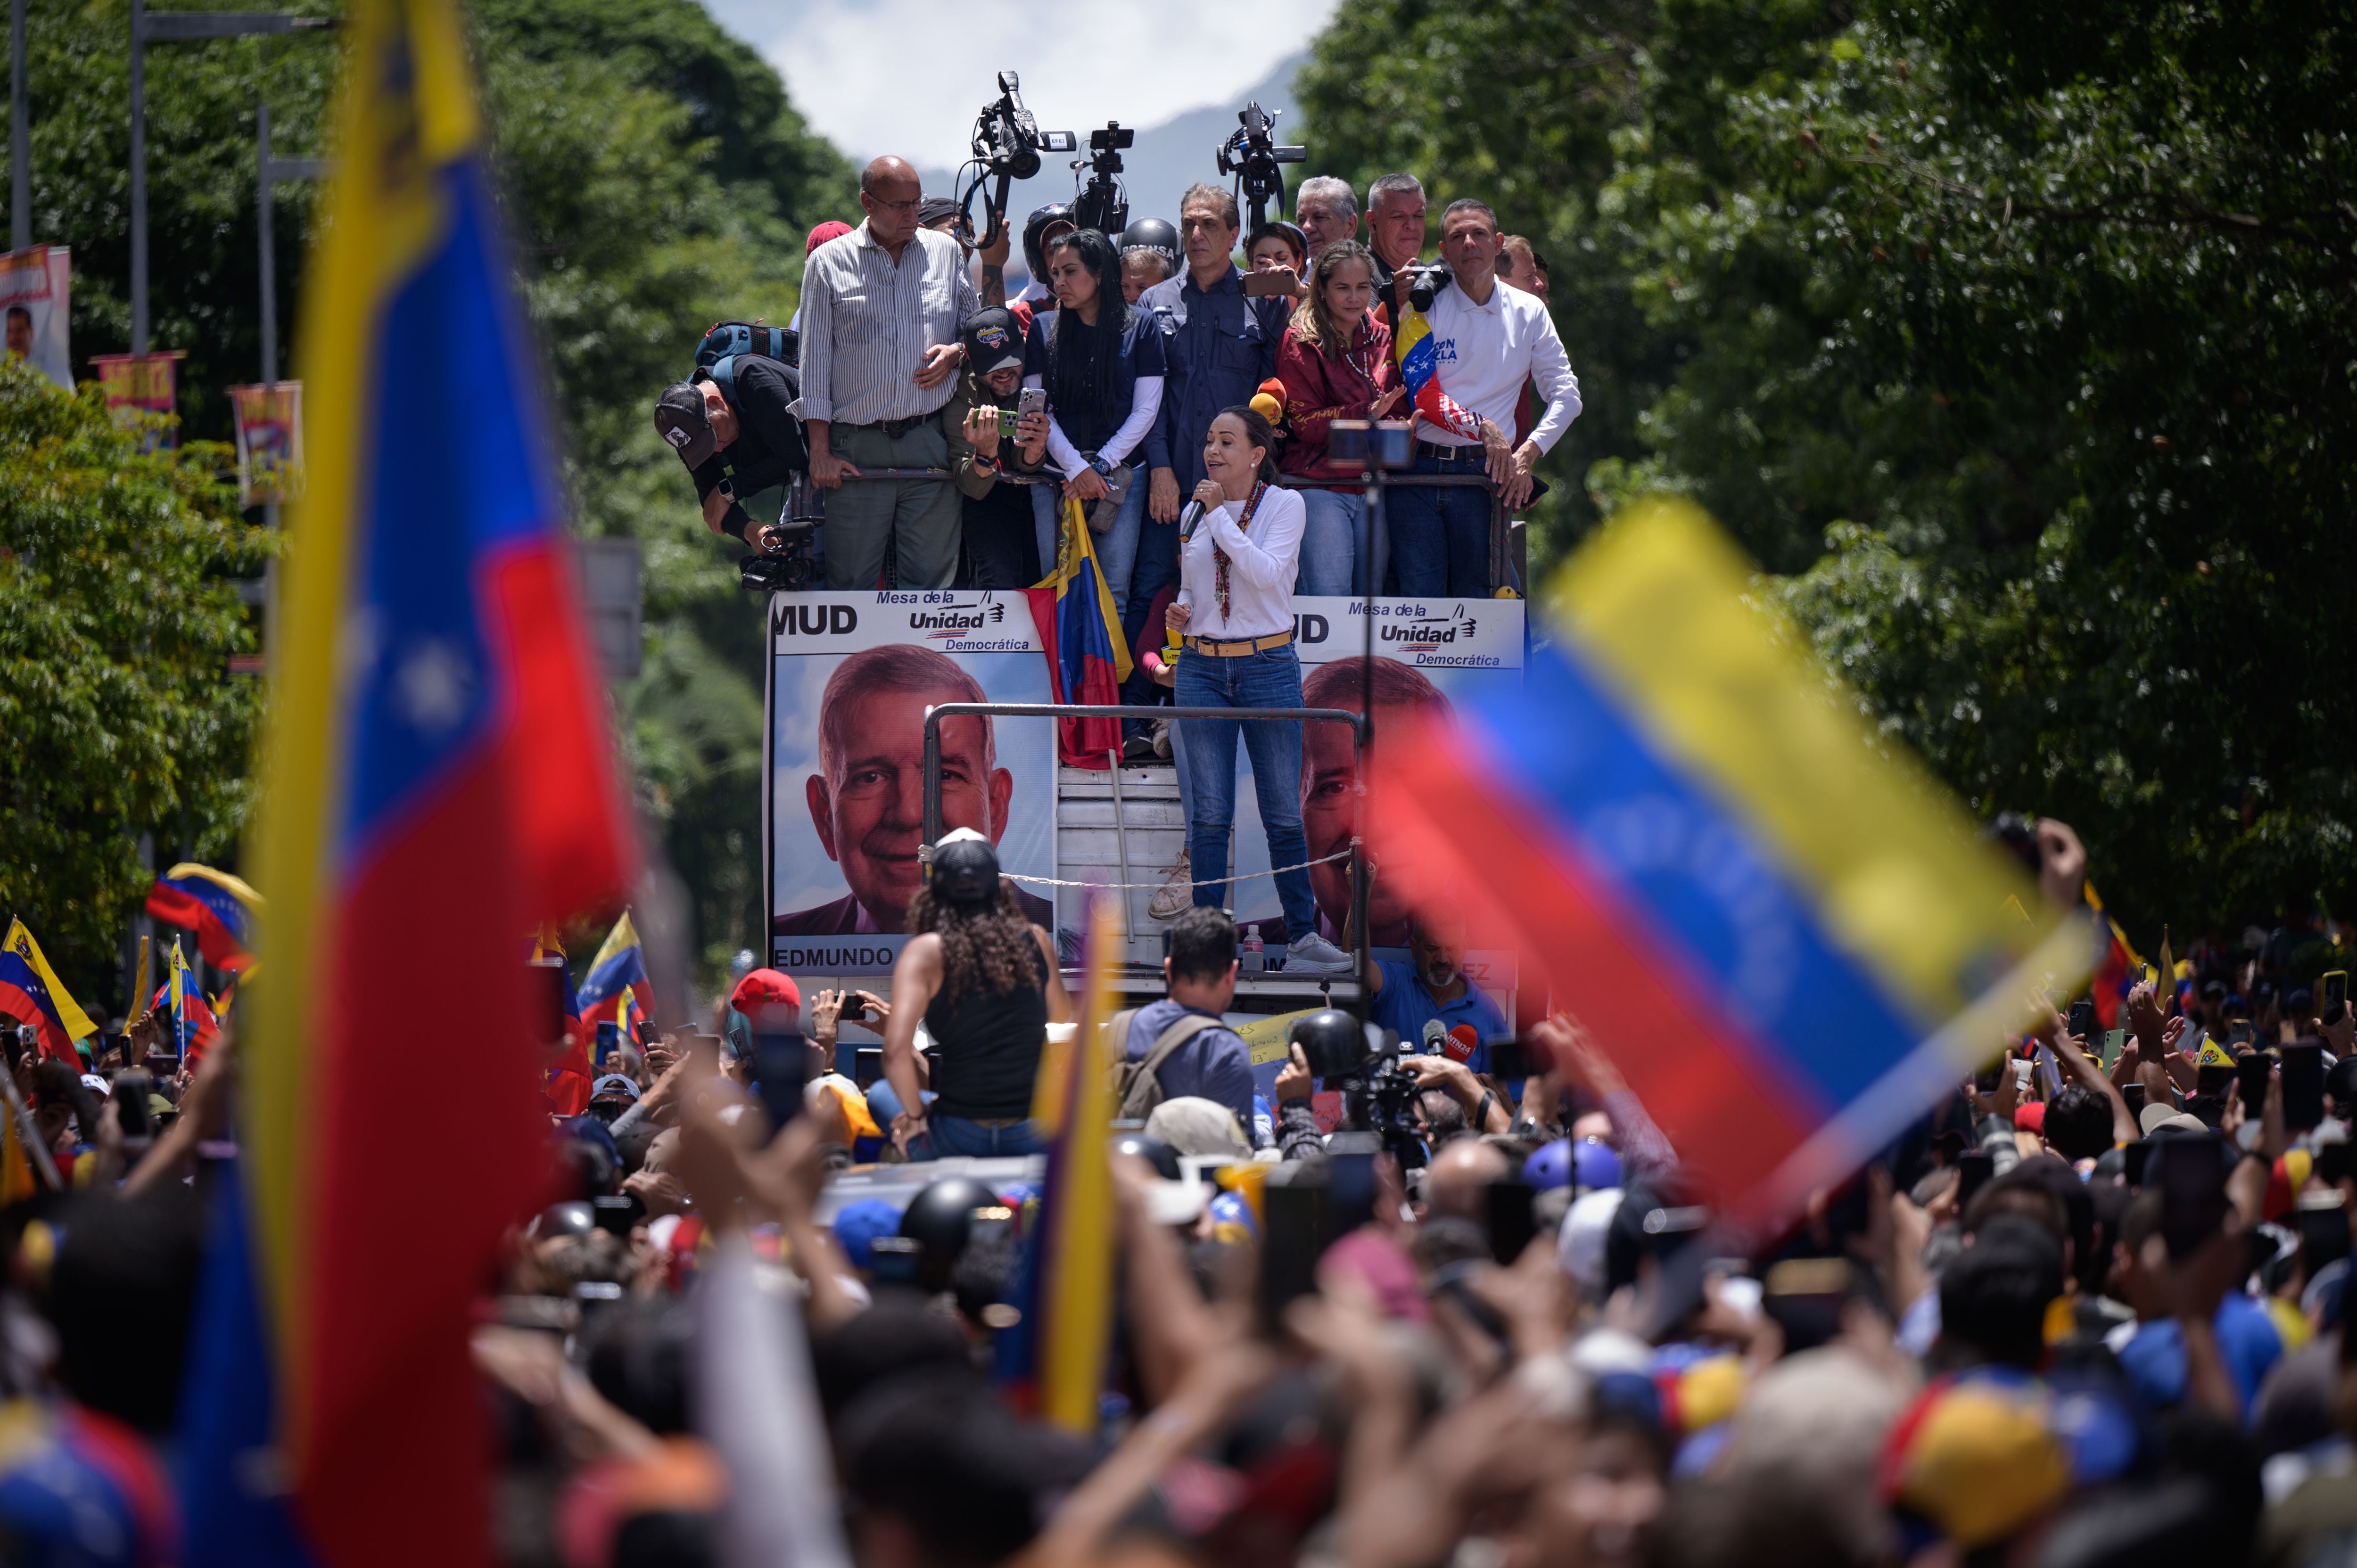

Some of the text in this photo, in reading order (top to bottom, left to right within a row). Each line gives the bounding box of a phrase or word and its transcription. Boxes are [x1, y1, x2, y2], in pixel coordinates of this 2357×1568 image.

[876, 591, 918, 604] Mesa
[1349, 602, 1390, 616] Mesa
[910, 613, 985, 628] Unidad
[1381, 625, 1456, 642] Unidad
[946, 639, 1029, 650] Democrática
[1416, 653, 1500, 665] Democrática
[775, 948, 893, 967] EDMUNDO
[1448, 1034, 1471, 1053] NTN24
